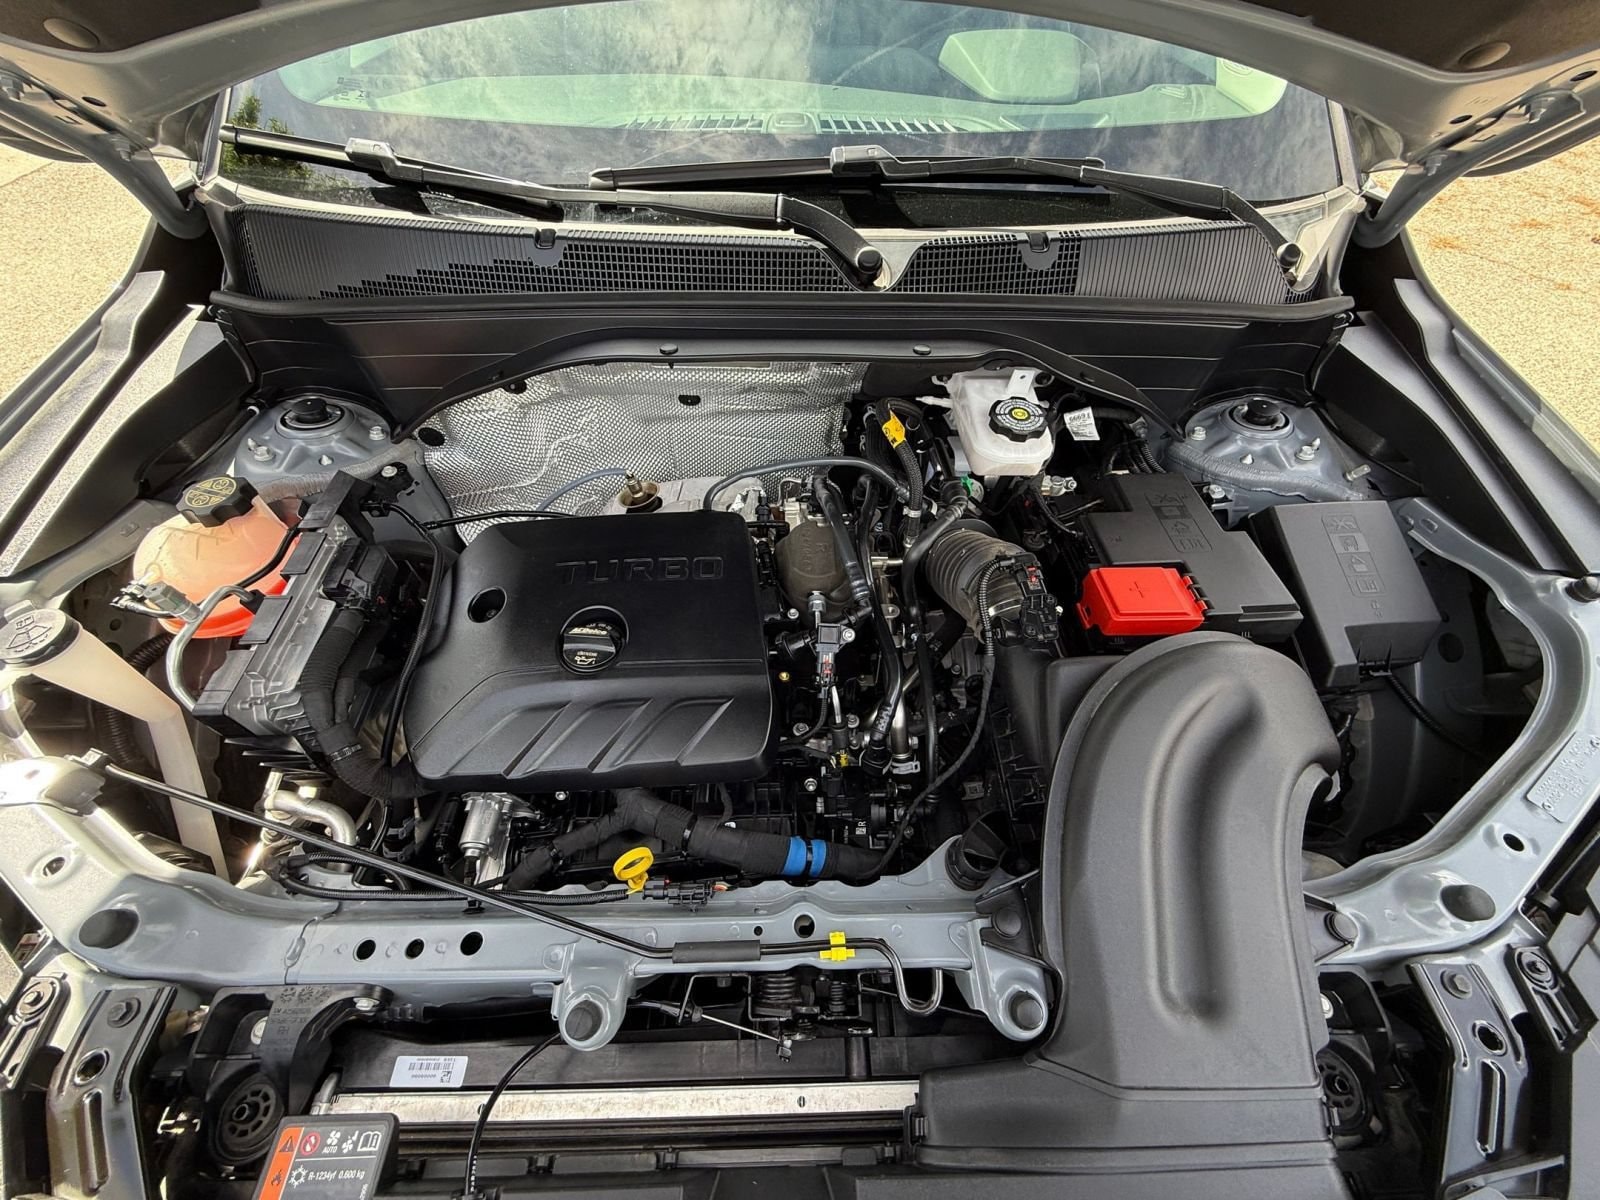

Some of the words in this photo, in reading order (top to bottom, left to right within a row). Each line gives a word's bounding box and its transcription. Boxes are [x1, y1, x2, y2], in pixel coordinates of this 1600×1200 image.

[555, 557, 724, 585] TURBO
[321, 1145, 338, 1155] AUTO
[308, 1169, 337, 1182] R-1234yf
[356, 1168, 366, 1180] kg
